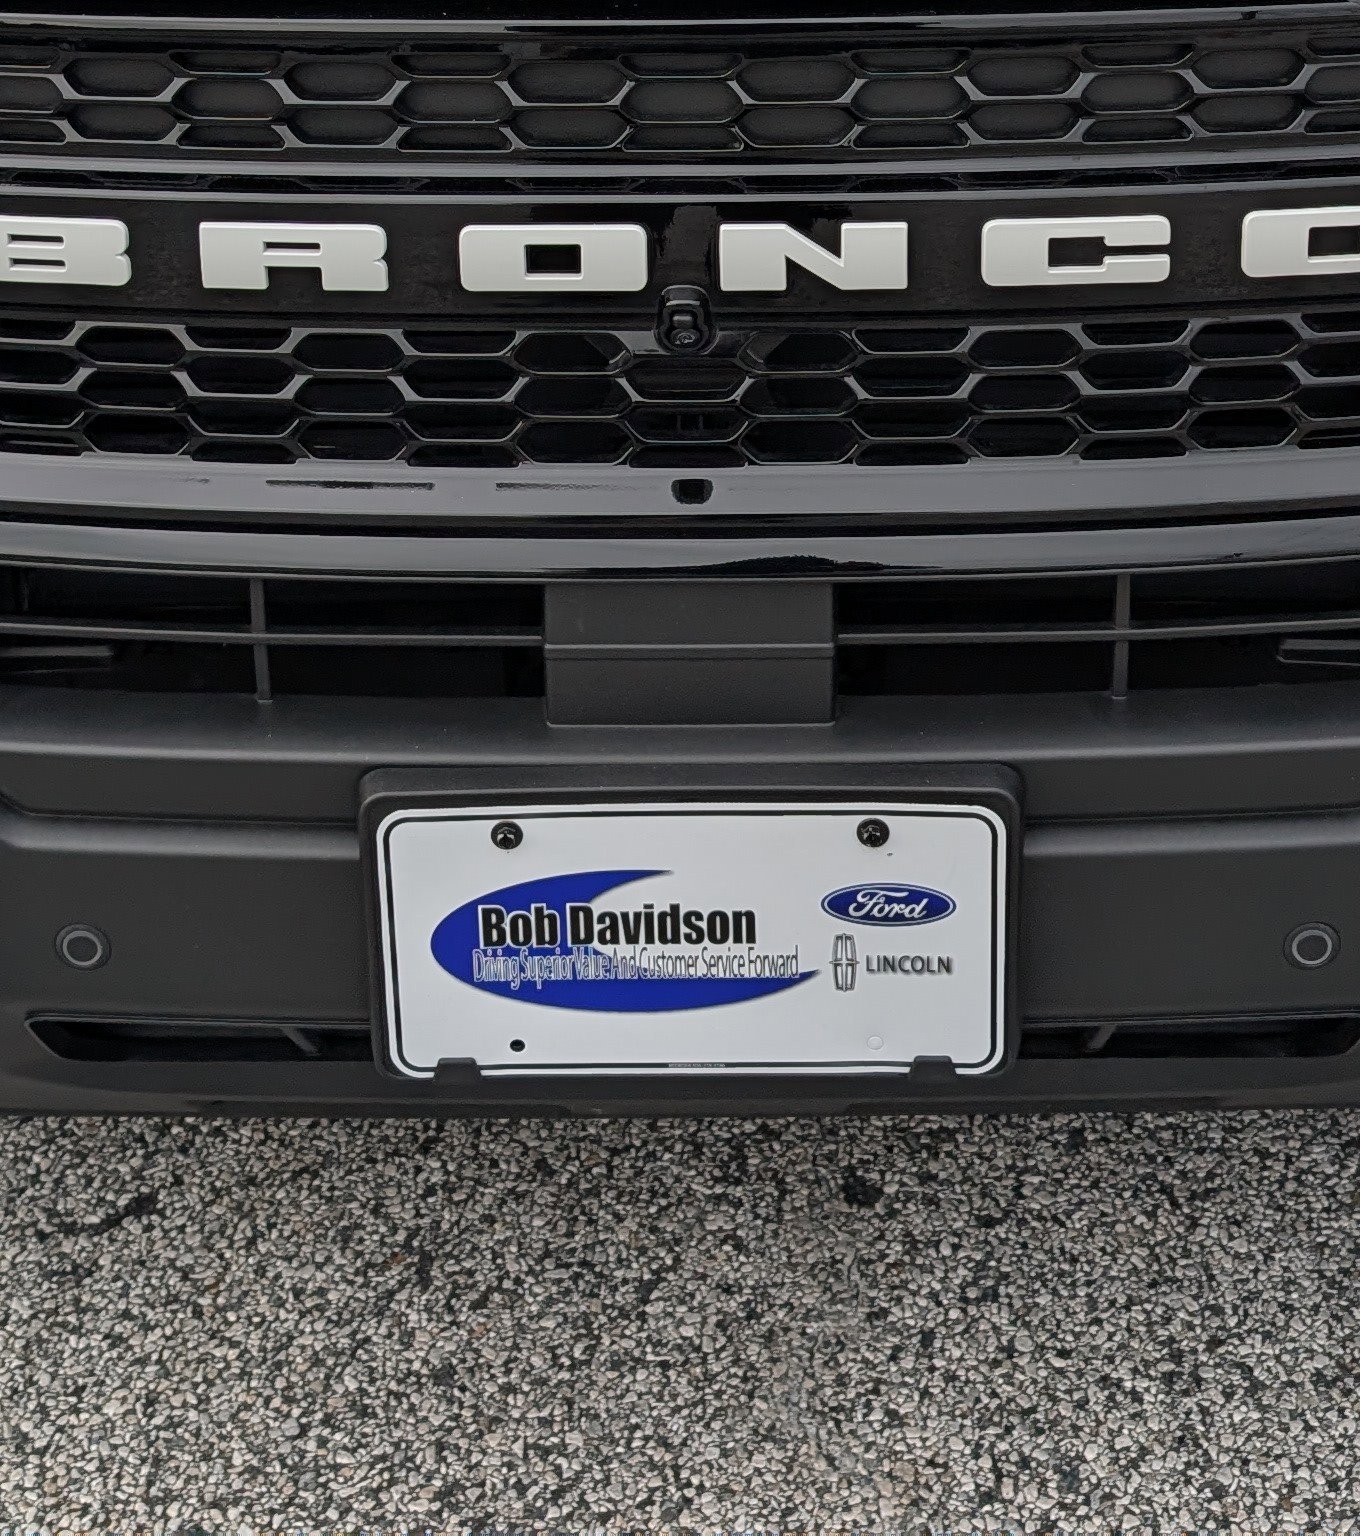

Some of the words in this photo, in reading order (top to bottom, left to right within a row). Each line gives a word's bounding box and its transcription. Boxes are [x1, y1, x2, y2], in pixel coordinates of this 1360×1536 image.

[848, 889, 930, 919] Ford
[481, 903, 559, 948] Bob
[567, 902, 757, 946] Davidson
[473, 948, 520, 990] Driving
[521, 946, 574, 990] Superior
[574, 946, 611, 980] Value
[611, 946, 638, 979] And
[639, 947, 700, 979] Customer
[701, 945, 746, 979] Service
[747, 944, 800, 979] Forward
[865, 954, 951, 974] LINCOLN
